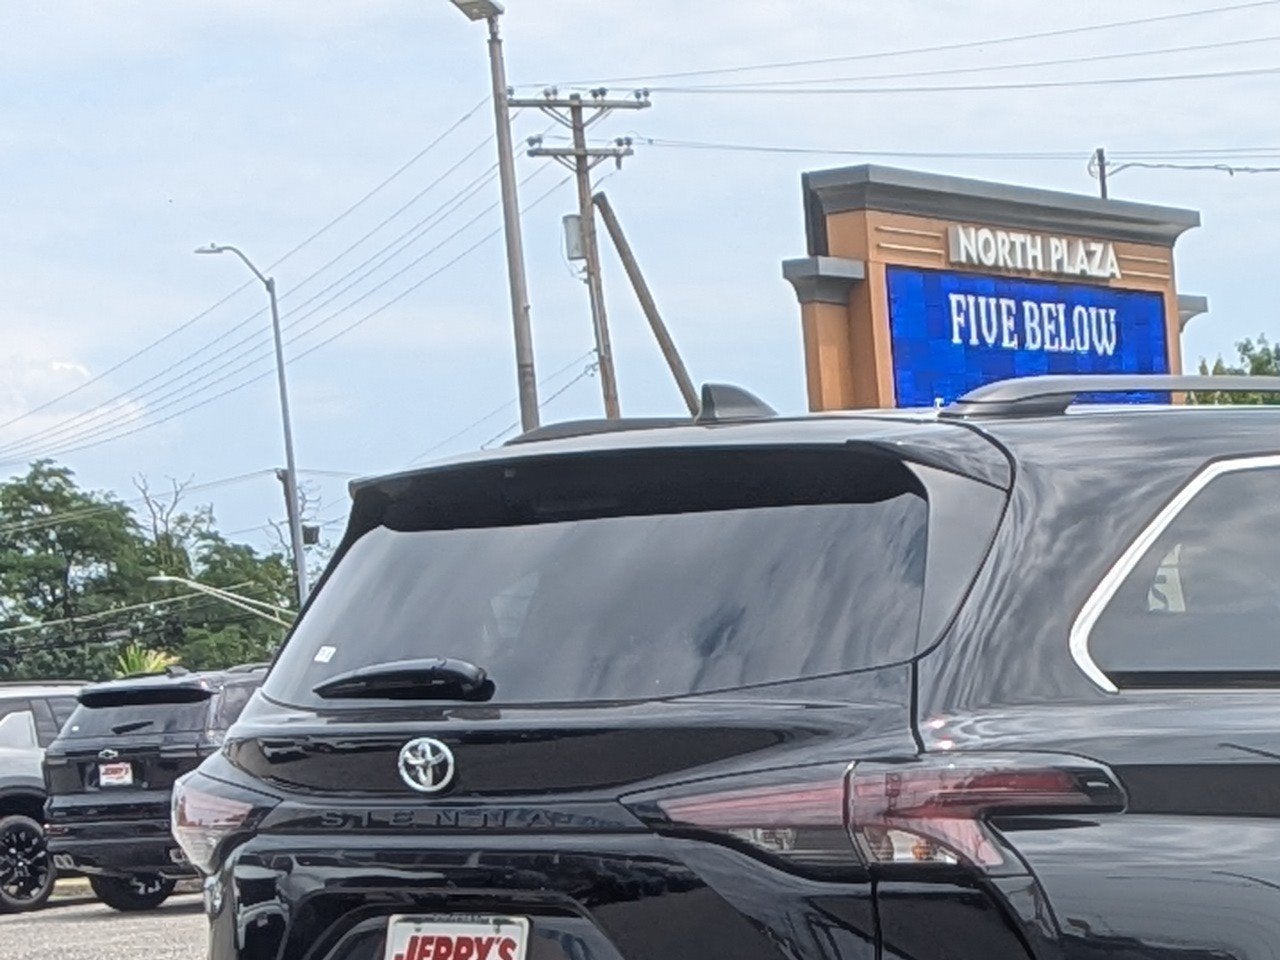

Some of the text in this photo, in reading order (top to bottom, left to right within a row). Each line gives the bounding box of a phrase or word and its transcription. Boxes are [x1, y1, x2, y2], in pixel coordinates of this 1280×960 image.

[957, 225, 1122, 279] NORTH PLAZA
[949, 292, 1117, 357] FIVE BELOW
[320, 808, 556, 829] SIENNA
